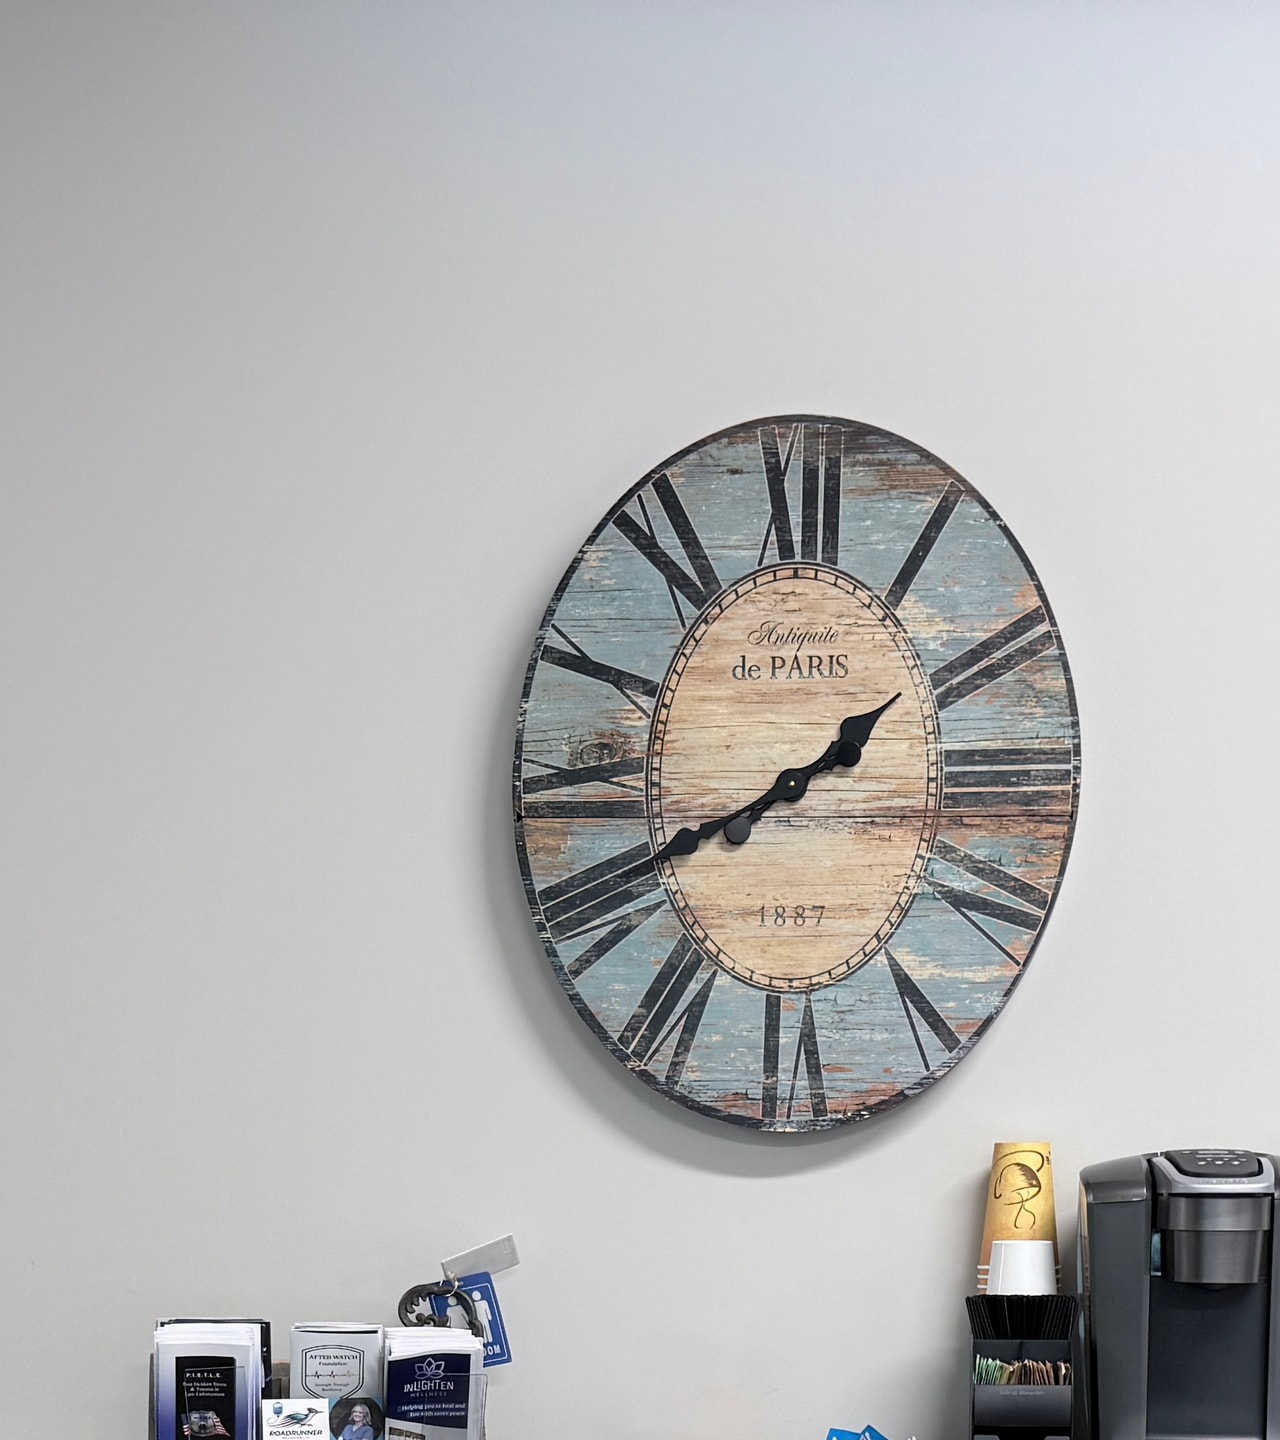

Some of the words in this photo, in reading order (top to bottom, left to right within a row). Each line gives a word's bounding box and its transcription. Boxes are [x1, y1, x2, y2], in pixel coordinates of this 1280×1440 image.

[757, 425, 844, 567] XII
[732, 655, 761, 680] de
[770, 653, 849, 679] PARIS
[758, 904, 826, 927] 1887
[403, 1379, 454, 1393] INLIGHTEN
